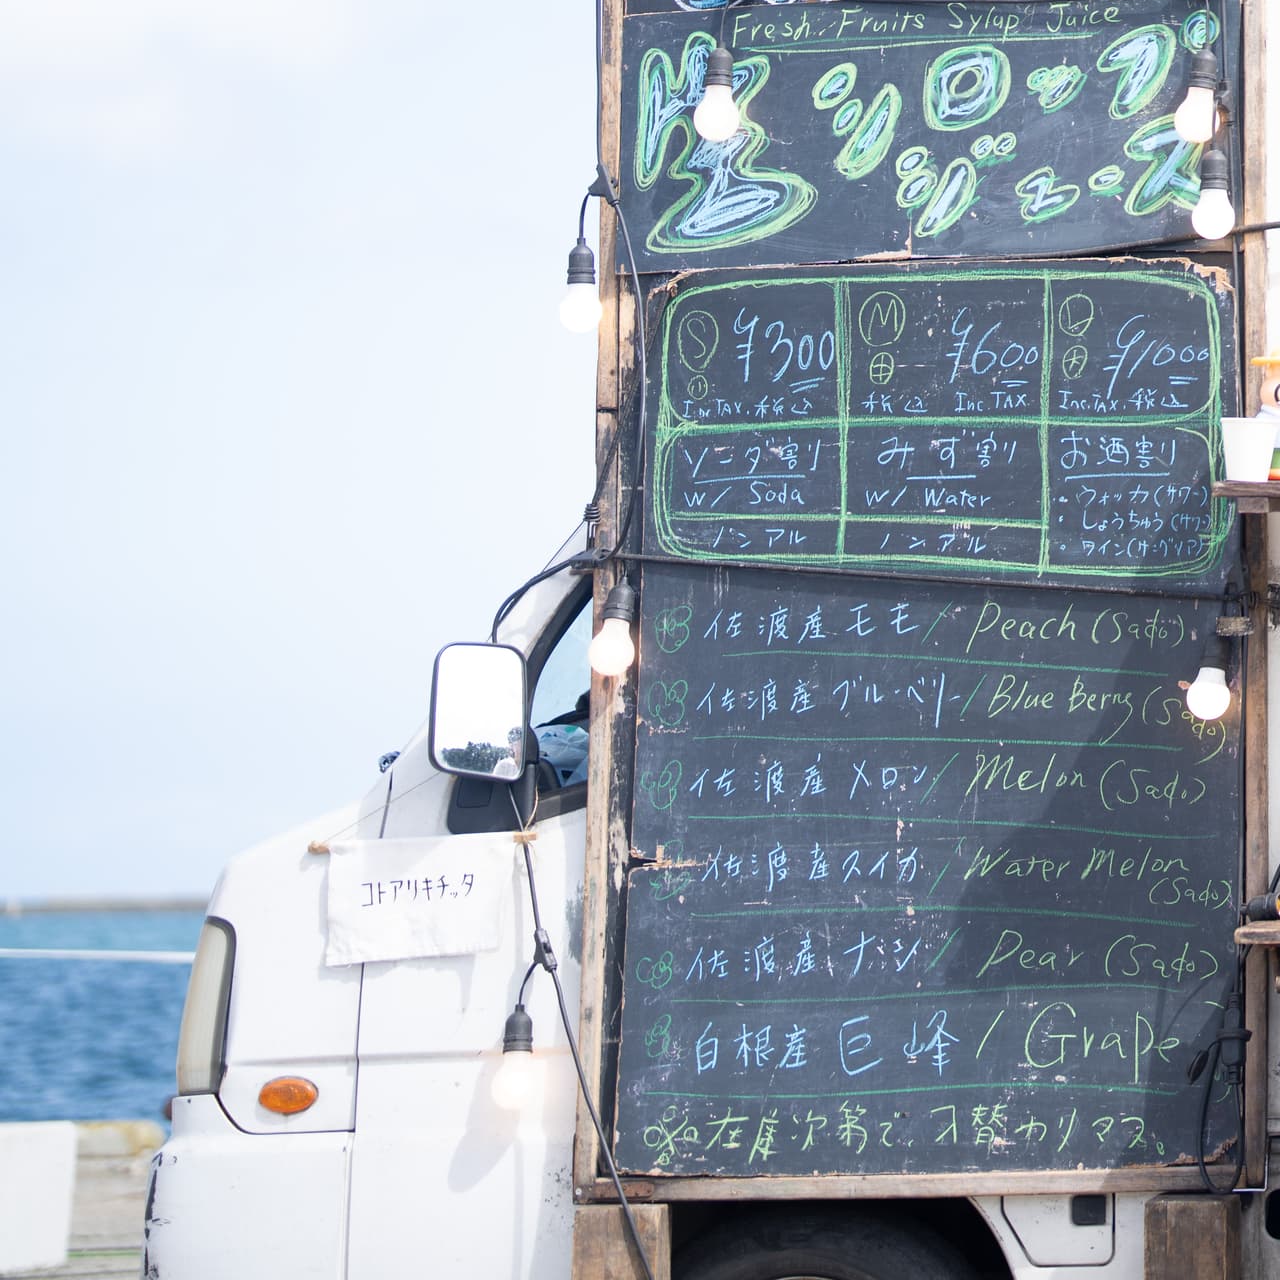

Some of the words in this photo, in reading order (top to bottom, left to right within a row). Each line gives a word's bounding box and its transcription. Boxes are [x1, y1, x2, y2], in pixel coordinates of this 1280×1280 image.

[732, 12, 811, 48] Fresh
[836, 6, 925, 38] Fruits
[1046, 3, 1122, 33] Juice
[865, 295, 900, 343] M
[1060, 430, 1176, 470] お酒割り
[750, 480, 805, 505] Soda
[924, 488, 992, 507] Water
[966, 600, 1076, 653] Peach
[988, 674, 1055, 719] Blue
[965, 753, 1087, 797] Melon
[964, 846, 1071, 882] Water
[1081, 846, 1191, 881] Melon
[976, 929, 1085, 979] Pear
[1024, 1001, 1181, 1085] Grape
